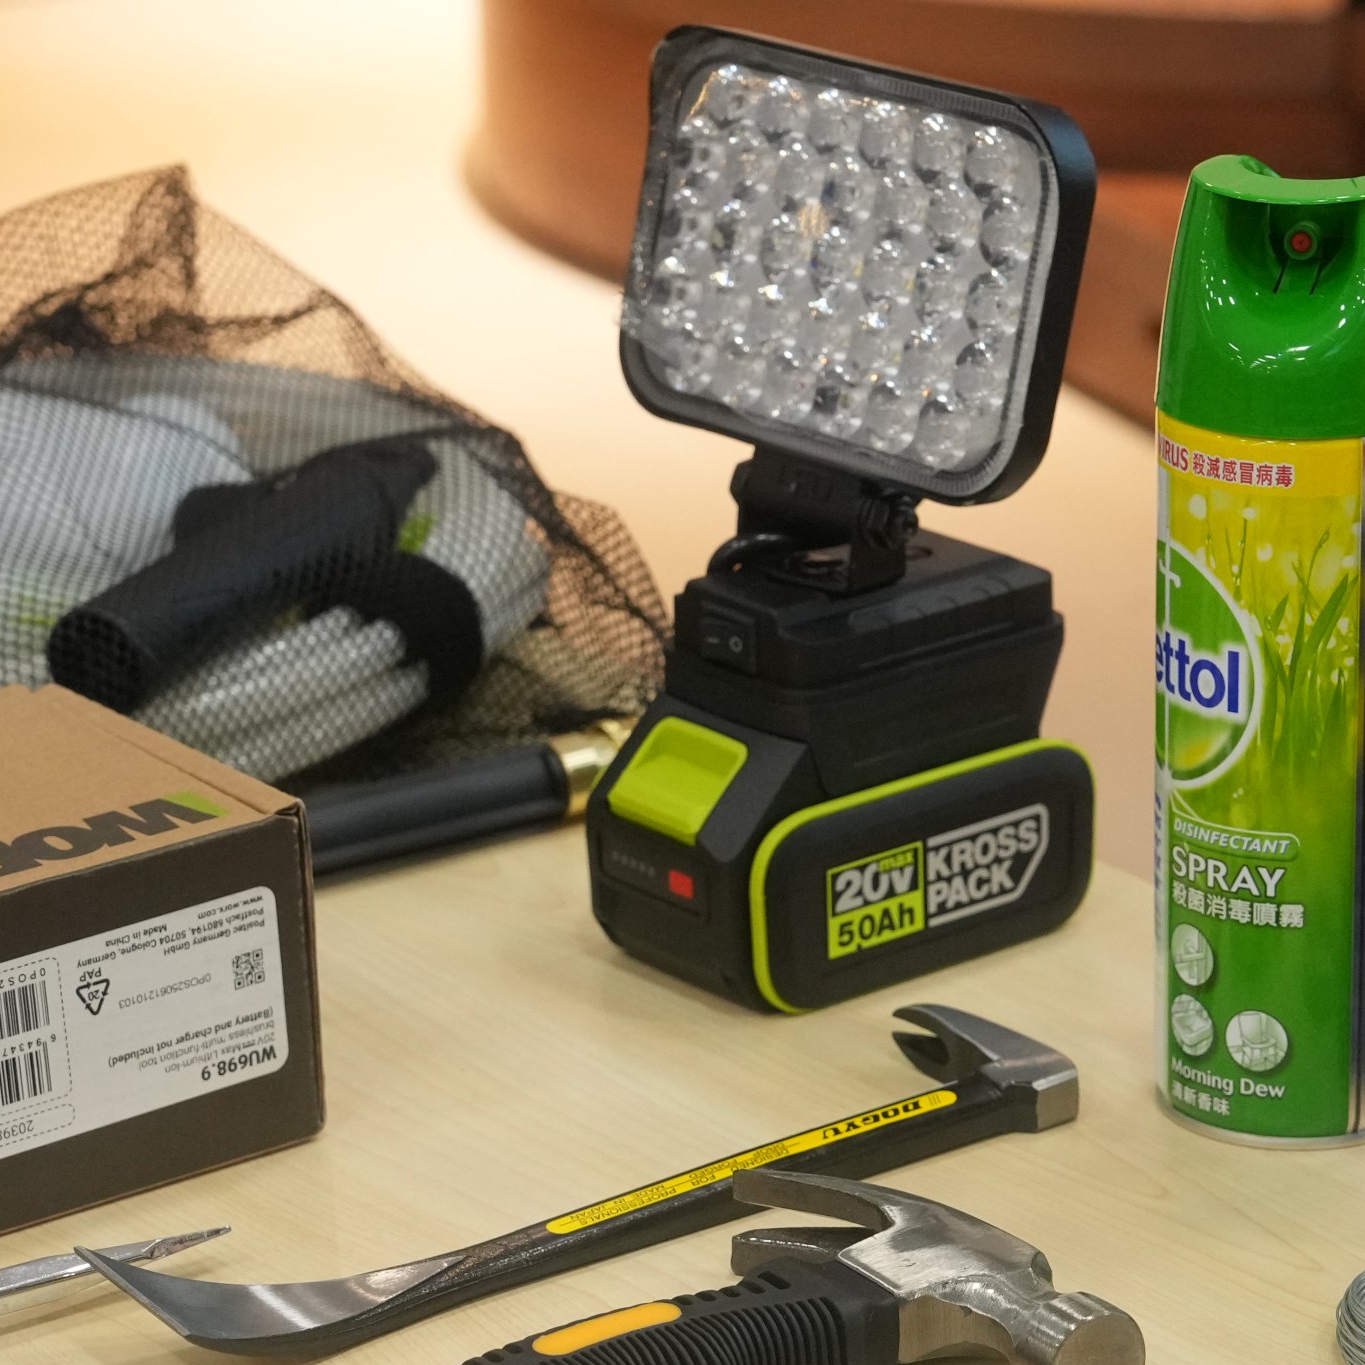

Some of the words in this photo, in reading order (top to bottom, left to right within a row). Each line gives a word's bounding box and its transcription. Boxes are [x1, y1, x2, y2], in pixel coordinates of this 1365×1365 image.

[1193, 452, 1293, 487] 殺滅感冒病毒
[1156, 630, 1239, 713] ettol
[1174, 818, 1290, 855] DISINFECTANT
[928, 818, 1038, 882] KROSS
[1171, 845, 1285, 897] SPRAY
[928, 859, 1015, 914] PACK
[198, 895, 264, 920] www.worx.com
[1172, 879, 1305, 928] 殺菌消毒噴霧
[225, 907, 264, 924] Postfach
[148, 923, 168, 935] Made
[233, 918, 265, 934] Positec
[105, 934, 131, 947] China
[132, 931, 141, 940] in
[159, 931, 187, 944] 50704
[192, 927, 231, 945] Germany
[119, 937, 158, 956] Cologne,
[164, 942, 191, 956] GmbH
[77, 951, 117, 969] Germany
[79, 967, 102, 982] PAP
[87, 989, 100, 1001] 20
[235, 1007, 273, 1026] (Battery
[216, 1021, 232, 1033] and
[229, 1020, 275, 1039] brushless
[51, 1034, 57, 1043] 6
[157, 1039, 173, 1050] not
[175, 1027, 213, 1046] charger
[108, 1044, 154, 1068] included)
[139, 1058, 159, 1072] tool
[201, 1044, 278, 1081] WU698.9
[1171, 1056, 1234, 1095] Morning
[1240, 1078, 1285, 1098] Dew
[822, 1100, 922, 1140] DOGYU
[753, 1143, 786, 1158] DROP
[688, 1158, 739, 1180] FORGED
[689, 1174, 716, 1187] FOR
[635, 1183, 667, 1199] MADE
[570, 1204, 610, 1222] JAPAN
[578, 1187, 678, 1227] PROFESSIONALS
